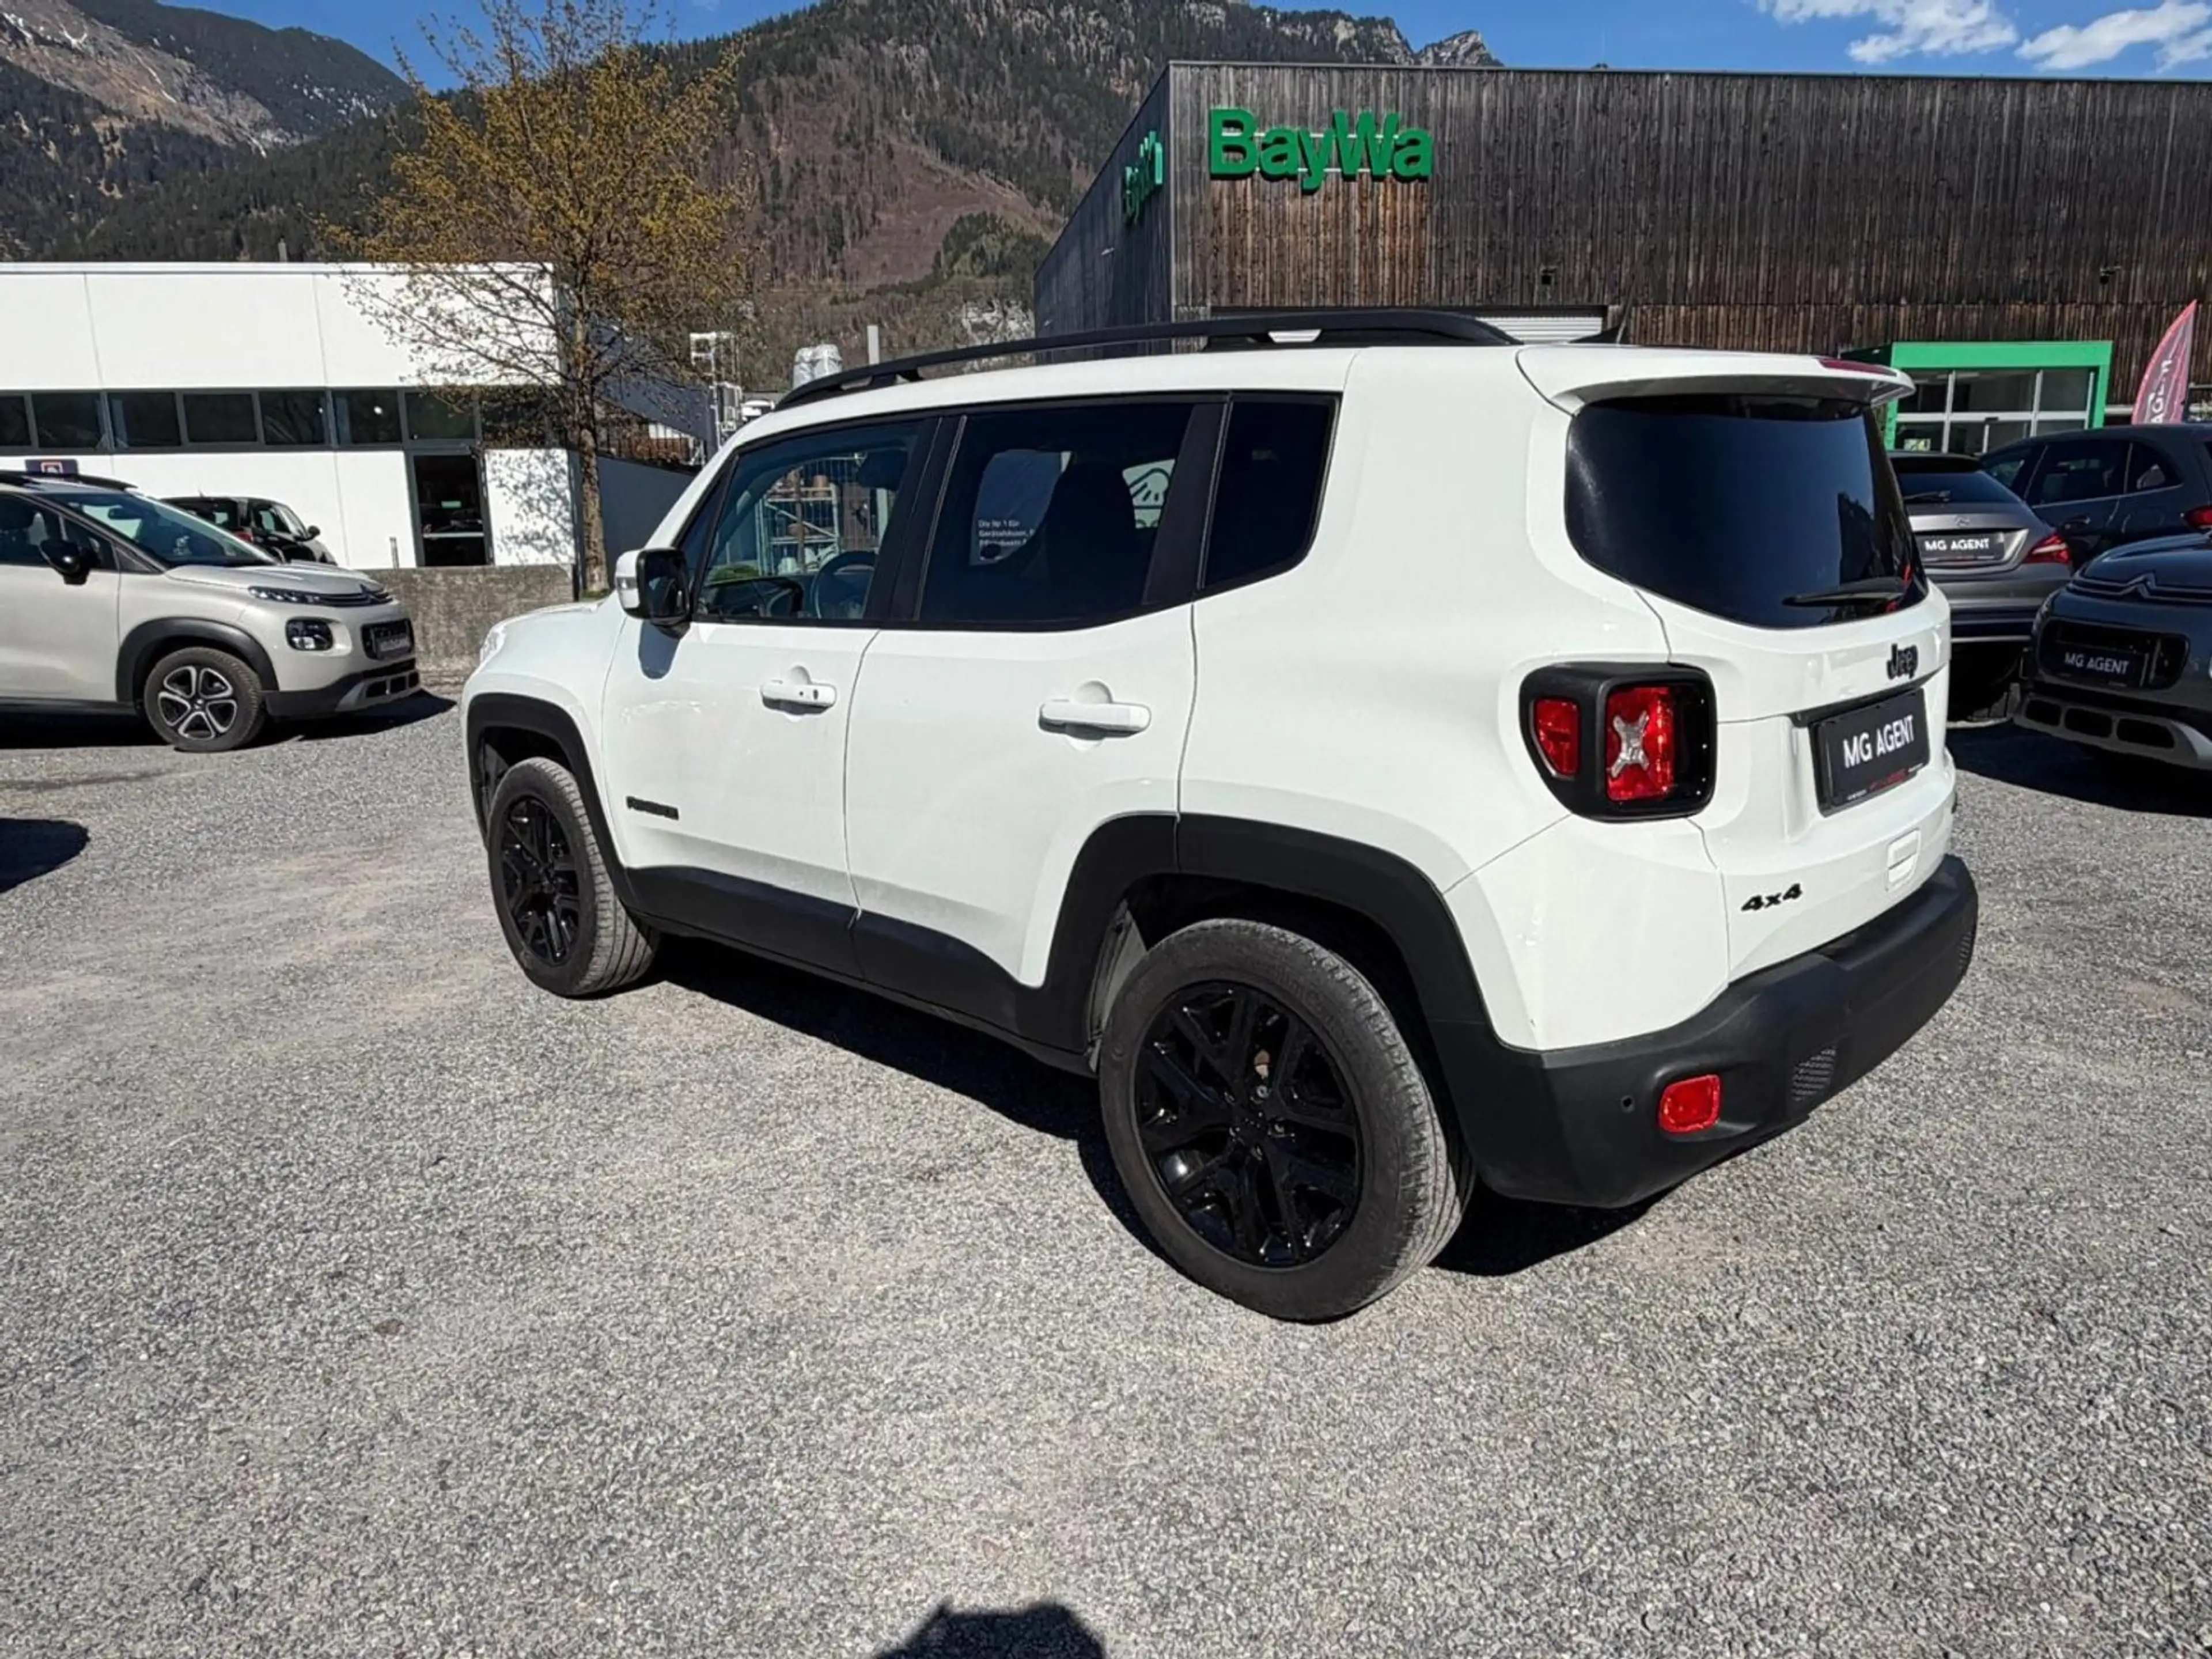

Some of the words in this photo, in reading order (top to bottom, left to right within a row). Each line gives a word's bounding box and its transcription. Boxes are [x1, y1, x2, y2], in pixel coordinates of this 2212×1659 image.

[1210, 108, 1432, 191] BayWa
[1925, 540, 1947, 551] MG
[1950, 538, 1990, 550] AGENT
[1887, 643, 1918, 680] Jeep
[2065, 652, 2084, 668] MG
[2086, 657, 2130, 675] AGENT
[1843, 732, 1872, 768] MG
[1876, 715, 1914, 757] AGENT
[1741, 883, 1803, 911] 4x4
